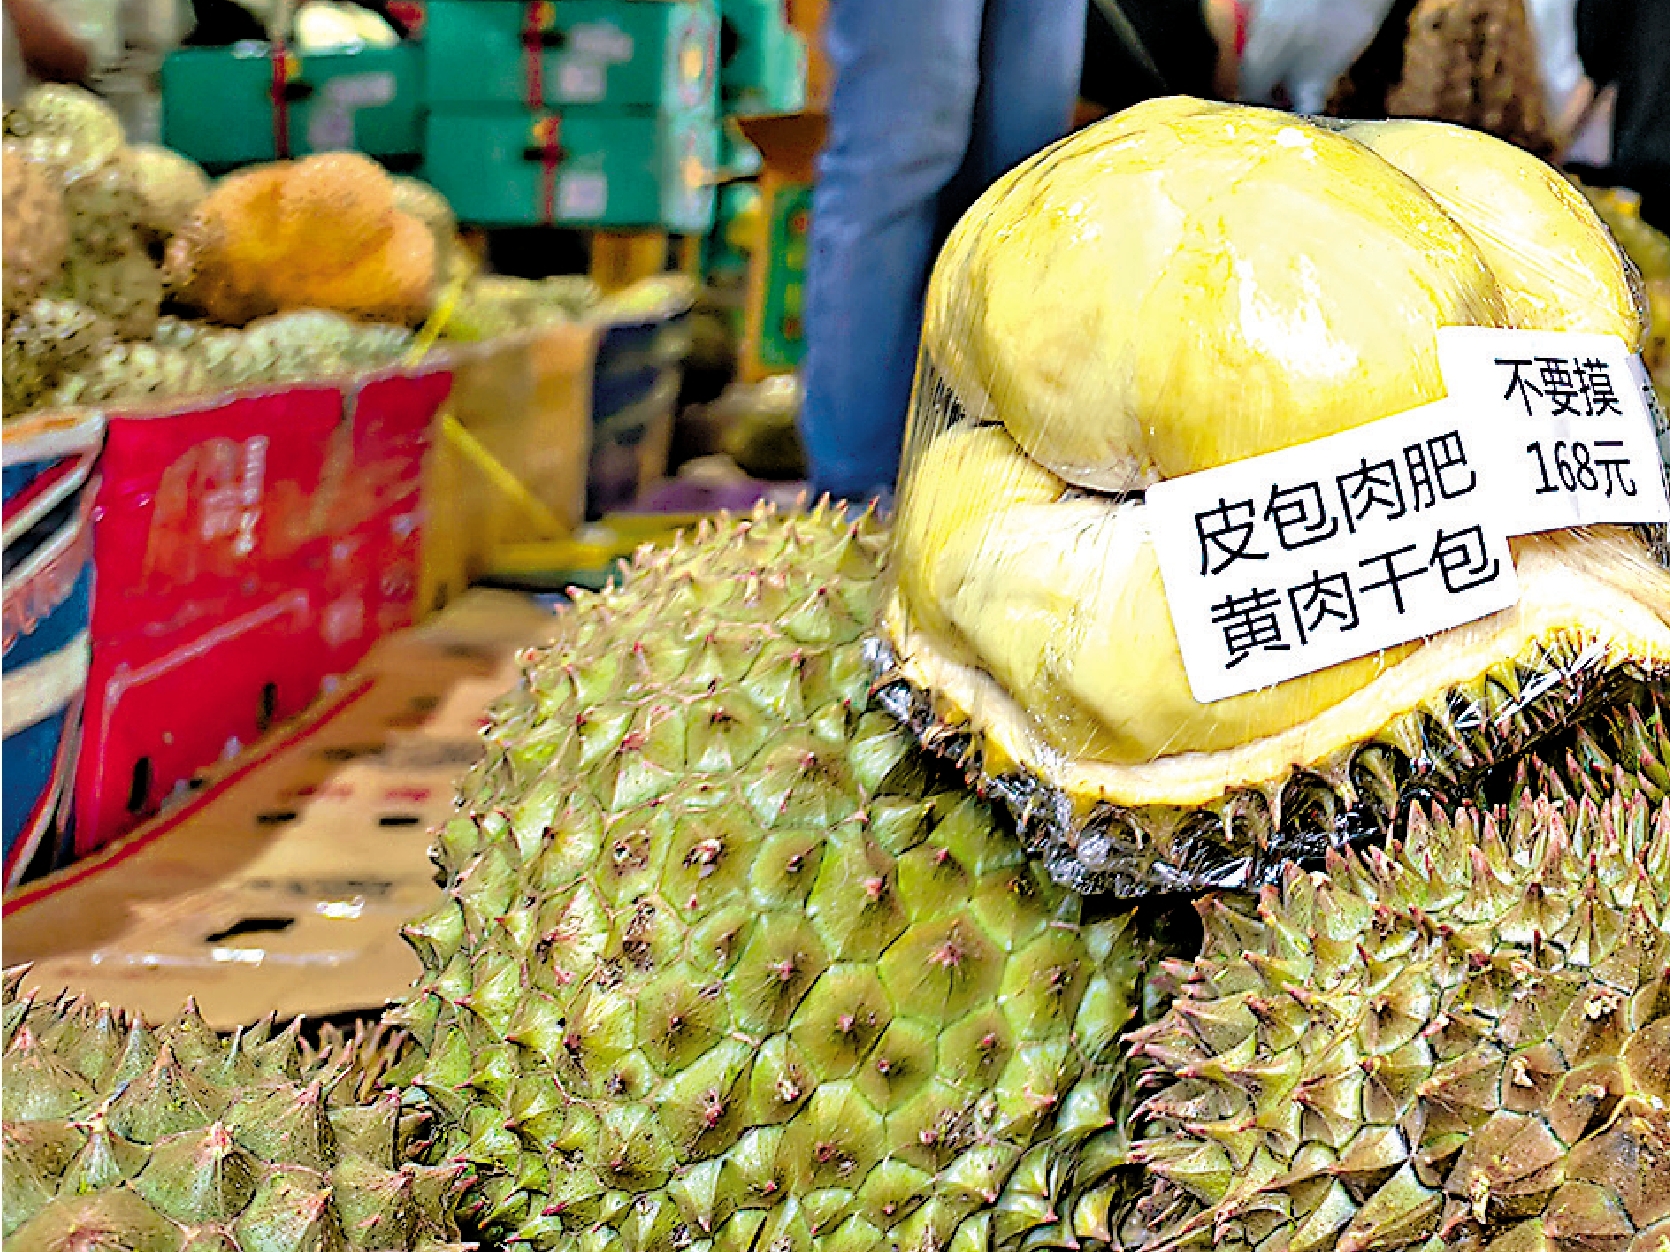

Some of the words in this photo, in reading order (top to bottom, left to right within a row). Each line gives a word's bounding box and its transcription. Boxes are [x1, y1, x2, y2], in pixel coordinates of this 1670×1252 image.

[1494, 357, 1624, 417] 不要摸
[1195, 430, 1477, 577] 皮包肉肥
[1526, 441, 1638, 498] 168元
[1210, 525, 1500, 669] 黄肉干包
